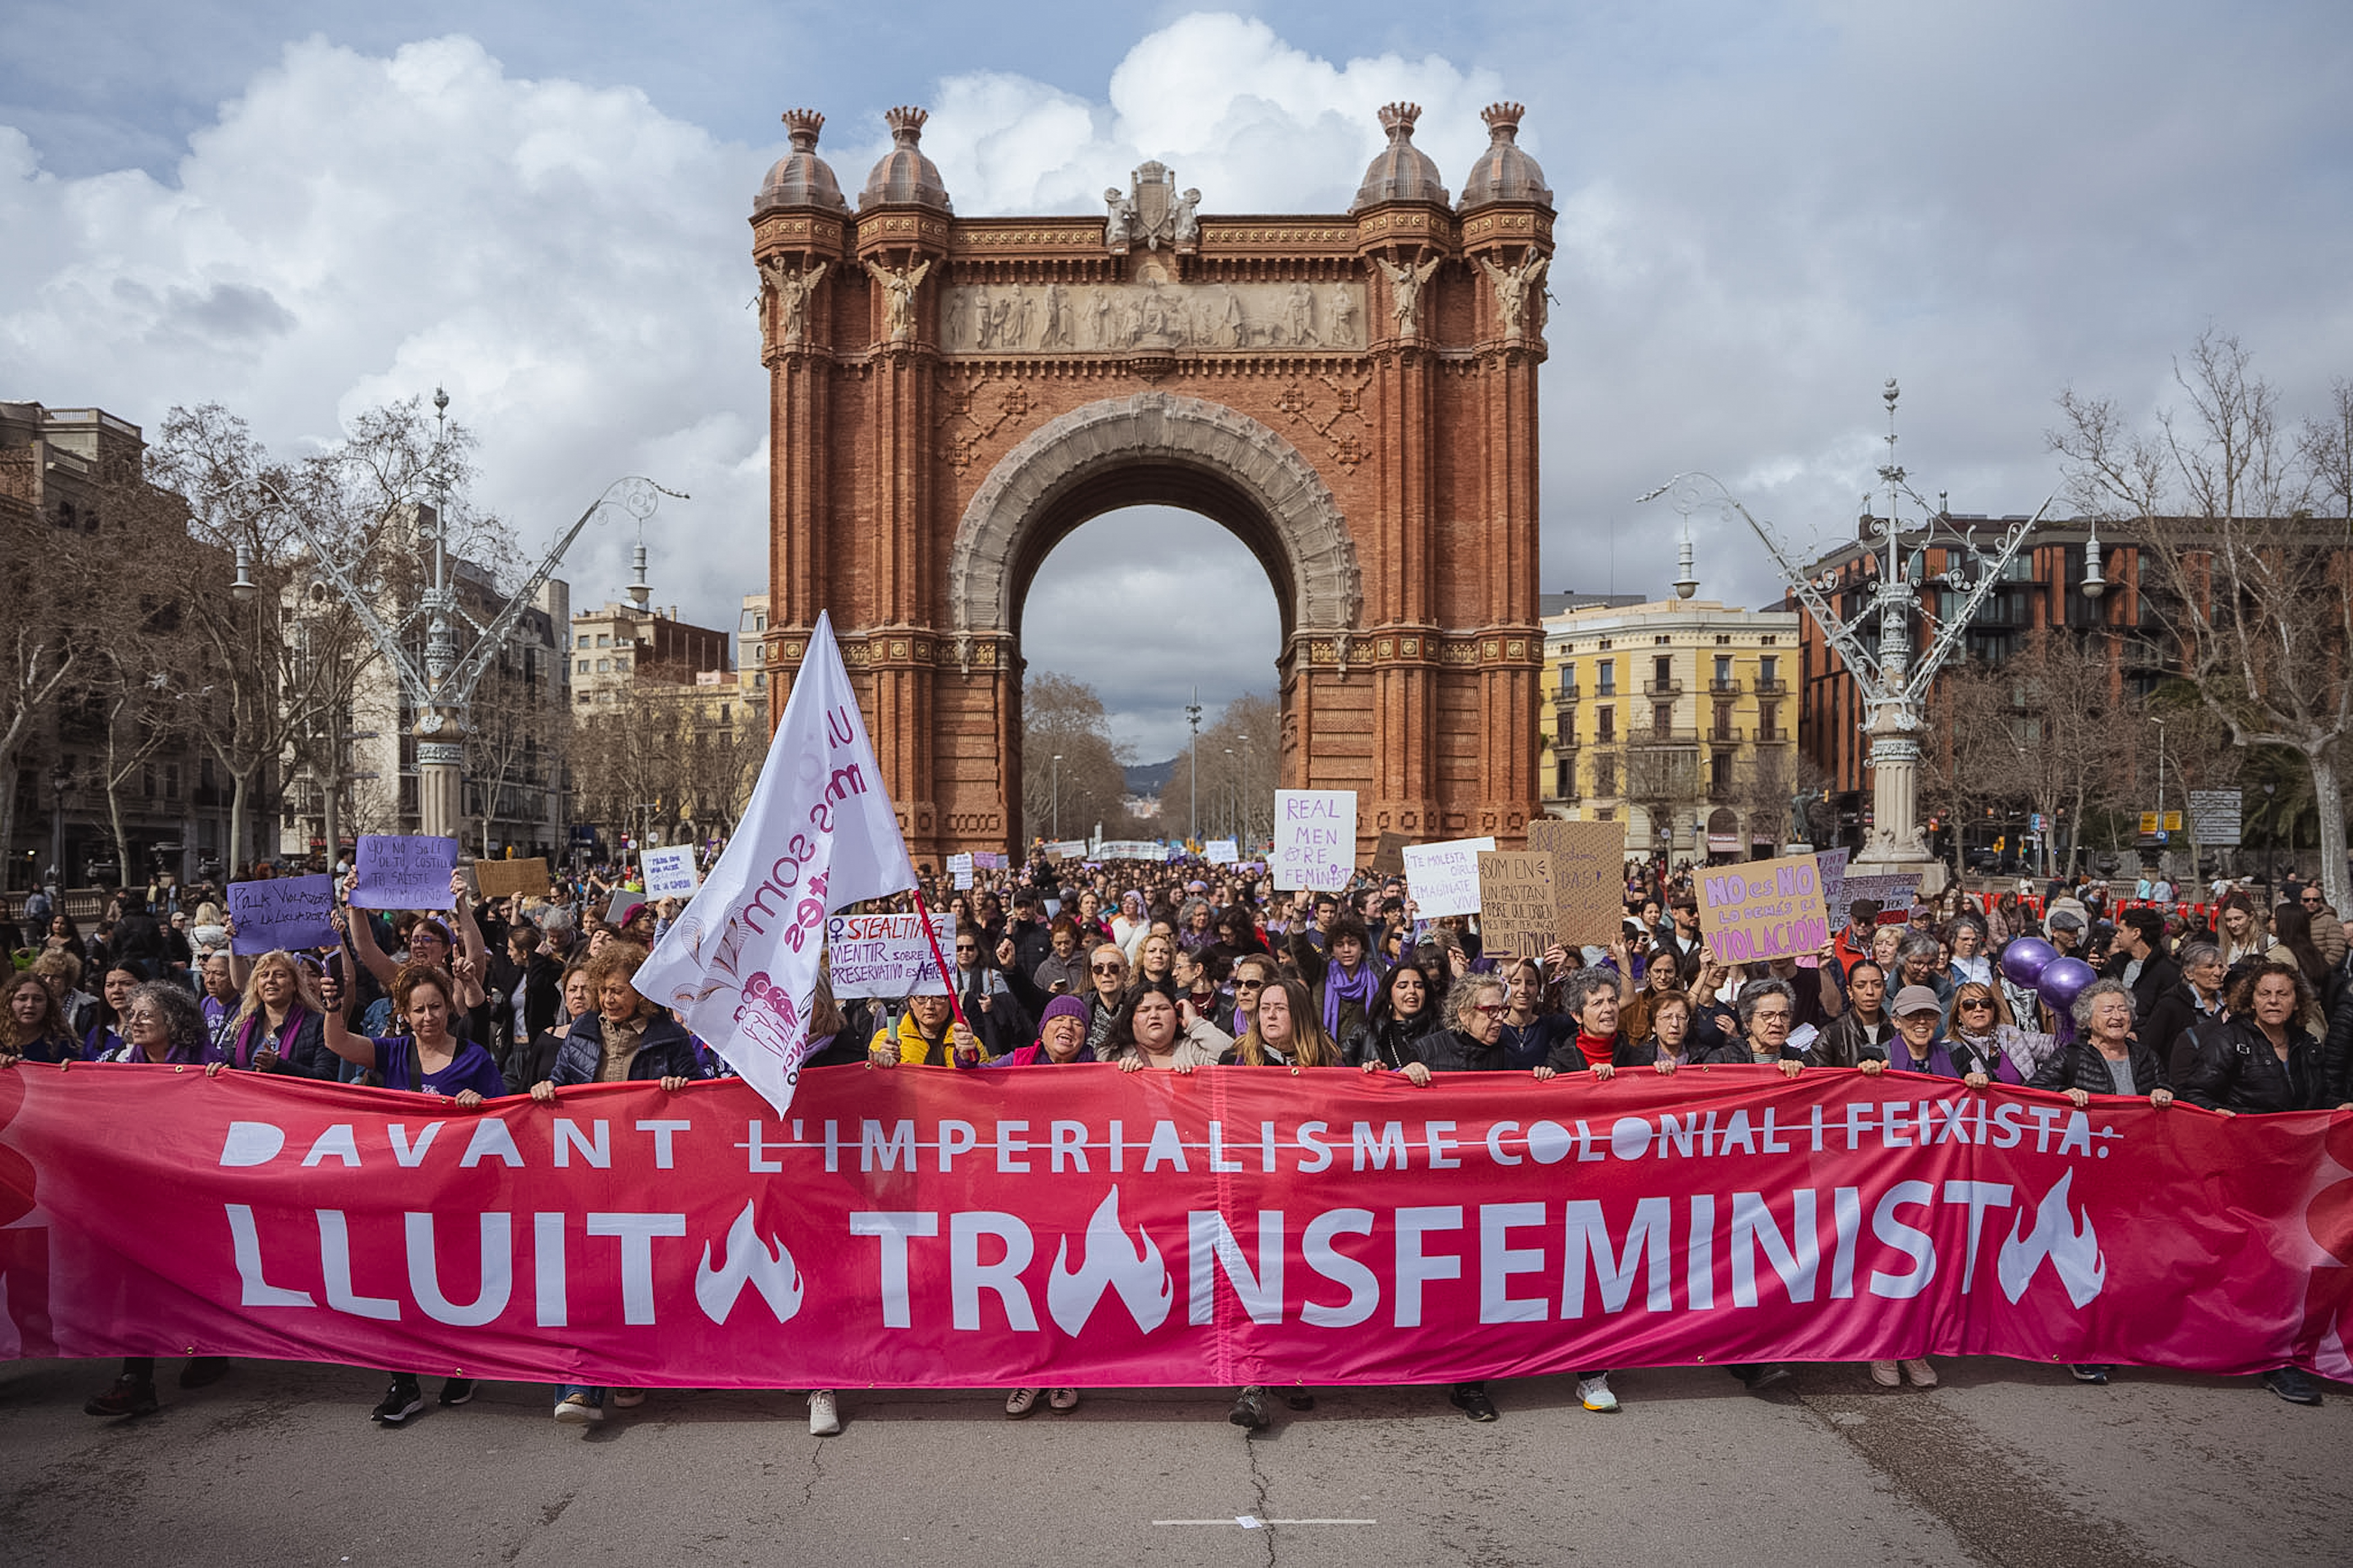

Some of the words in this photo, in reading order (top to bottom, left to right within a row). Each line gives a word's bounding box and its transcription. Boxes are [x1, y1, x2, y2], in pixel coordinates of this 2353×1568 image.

[1287, 798, 1341, 821] REAL
[1295, 827, 1337, 845] MEN
[1537, 825, 1562, 853] NO
[366, 839, 383, 863] YO
[393, 835, 405, 854] NO
[1428, 851, 1467, 867] MOLESTA
[1484, 858, 1509, 880] SOM
[1515, 858, 1535, 880] EN
[1483, 885, 1498, 900] UN
[1705, 874, 1747, 908] NO
[1776, 865, 1815, 898] NO
[237, 914, 252, 928] A
[1719, 910, 1740, 924] LO
[830, 942, 888, 964] MENTIR
[893, 950, 924, 961] SOBRE
[831, 963, 903, 985] PRESERVATIVO
[906, 967, 918, 977] ES
[219, 1117, 691, 1169] DAVANT
[748, 1117, 1463, 1174] L'IMPERIALISME
[1484, 1106, 1791, 1165] COLONIAL
[1810, 1104, 1823, 1152] I
